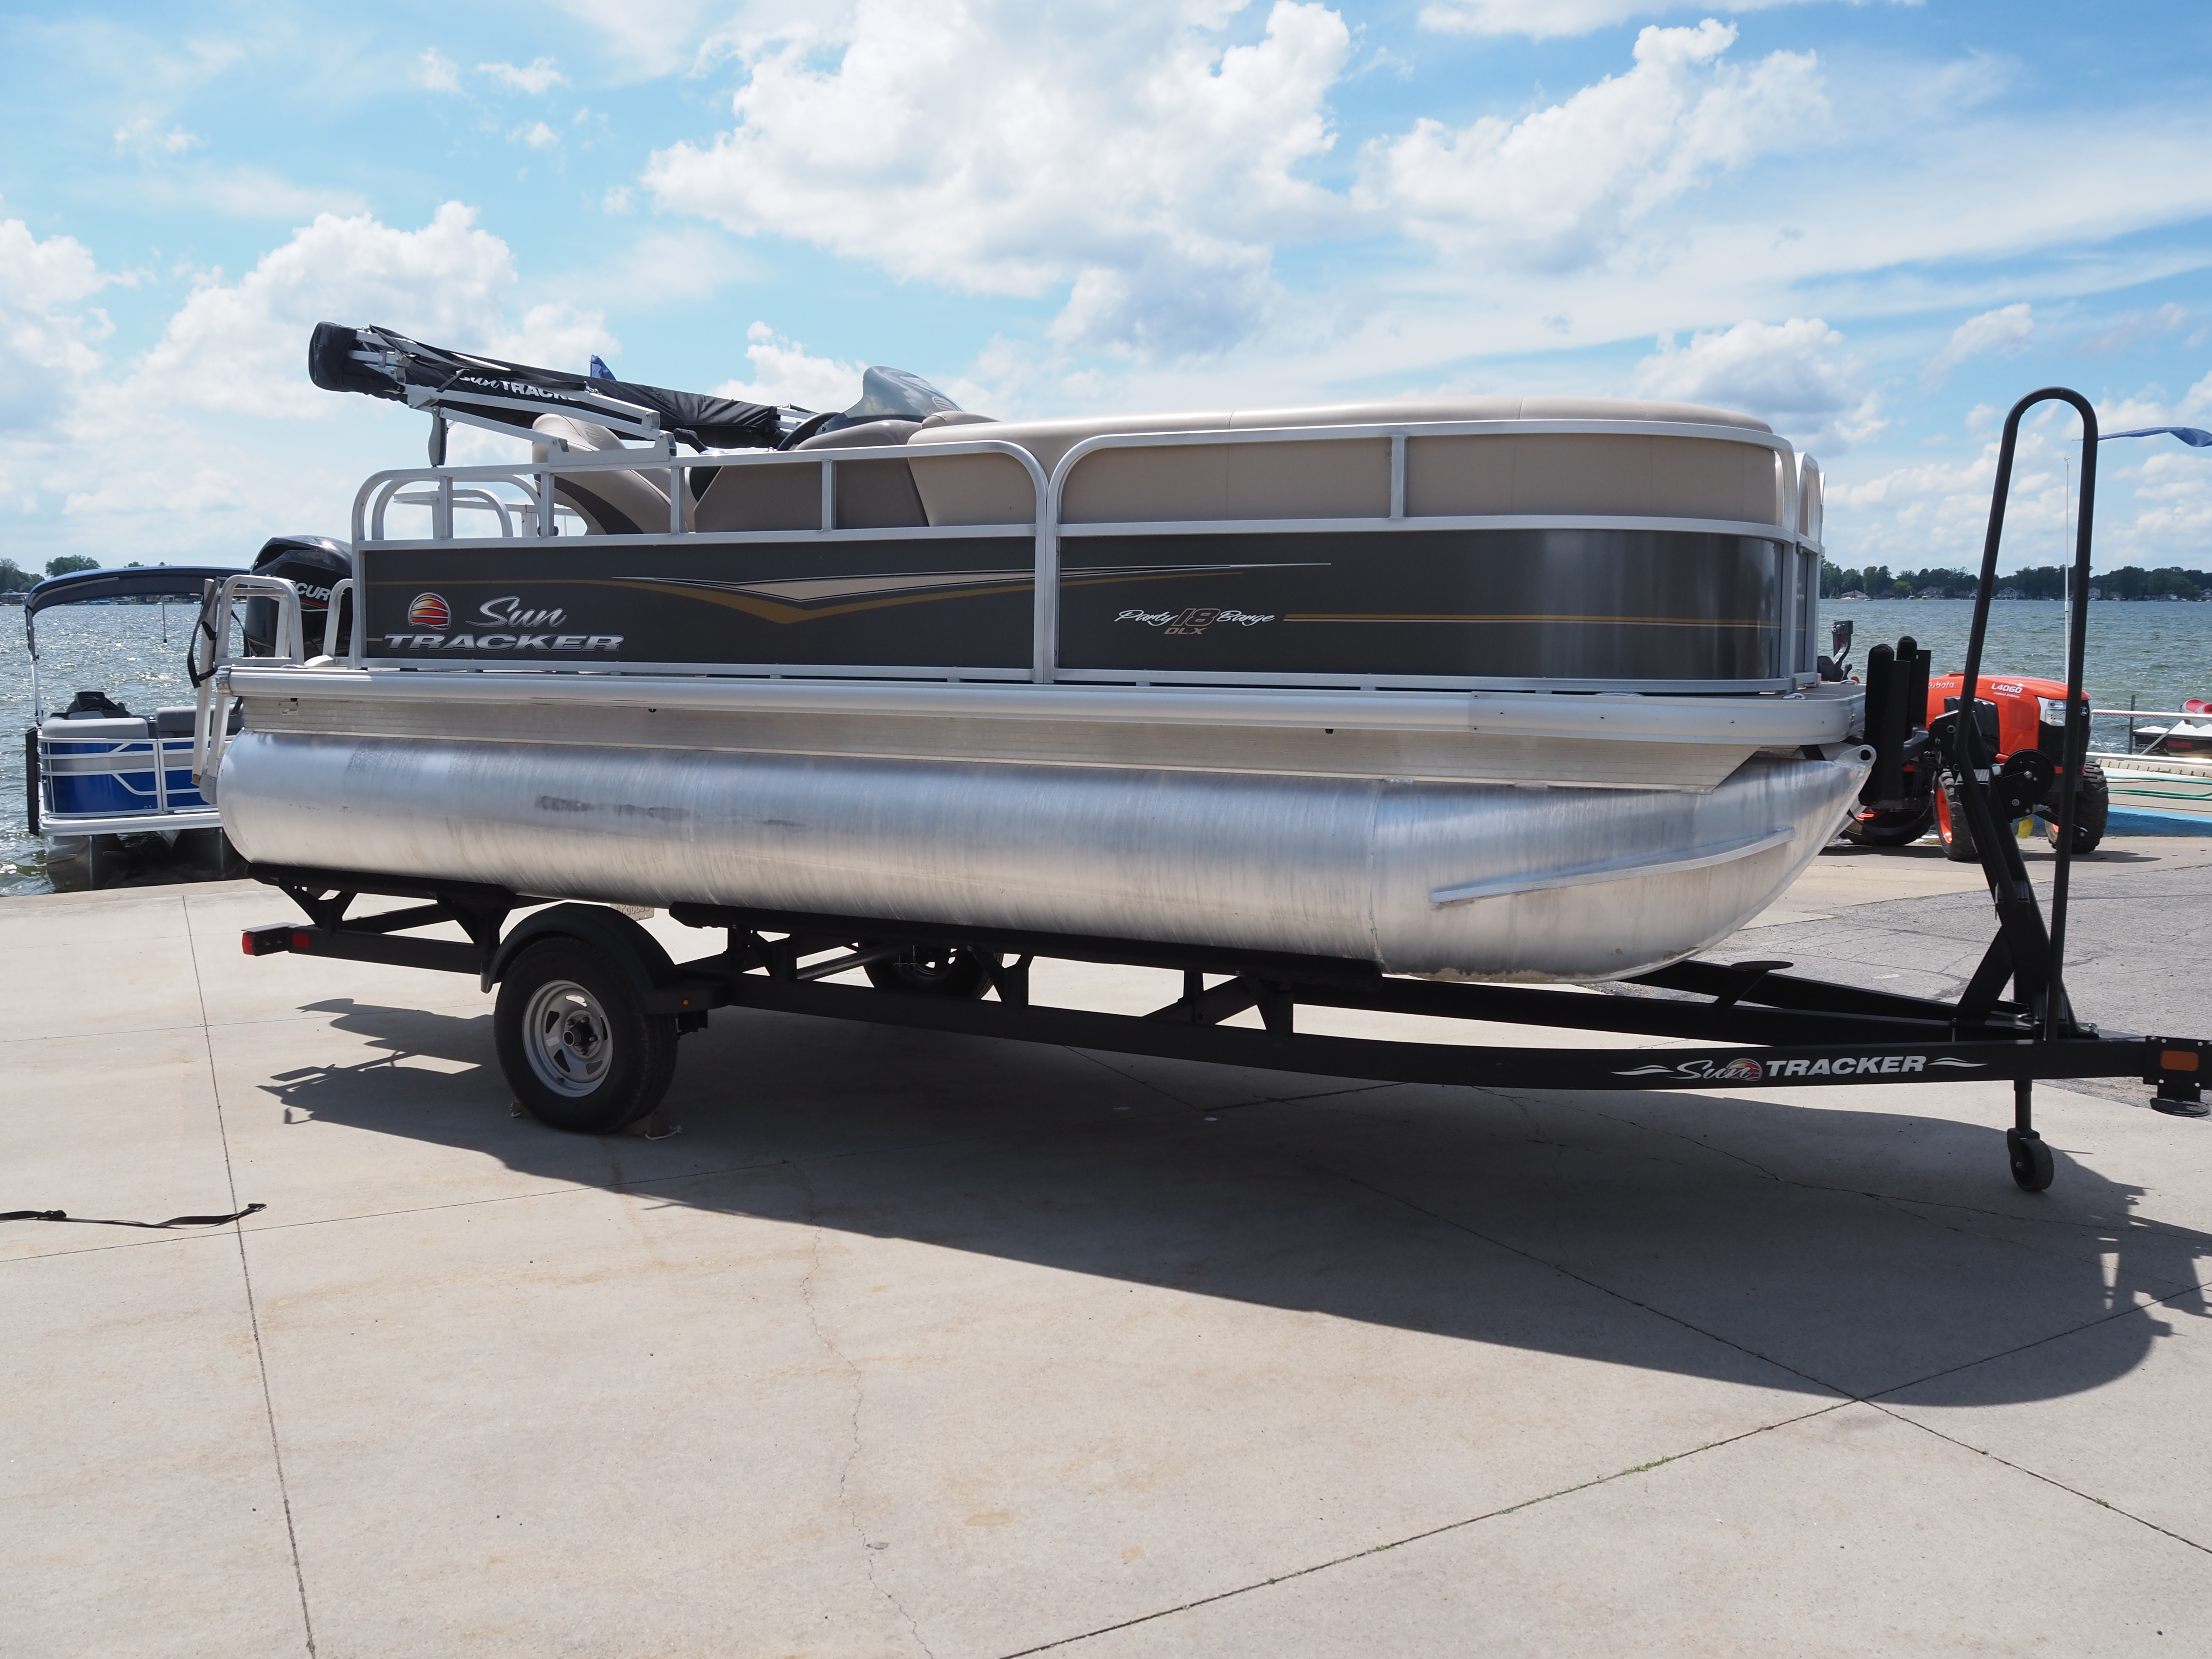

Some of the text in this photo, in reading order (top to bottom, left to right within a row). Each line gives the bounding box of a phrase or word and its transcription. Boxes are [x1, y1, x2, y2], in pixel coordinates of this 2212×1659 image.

[499, 380, 579, 401] TRAC
[466, 596, 567, 627] Sun
[1115, 608, 1275, 626] Party 18 Barge
[384, 634, 625, 651] TRACKER
[1991, 683, 2023, 693] L4060
[1666, 1056, 1927, 1079] Sun TRACKER
